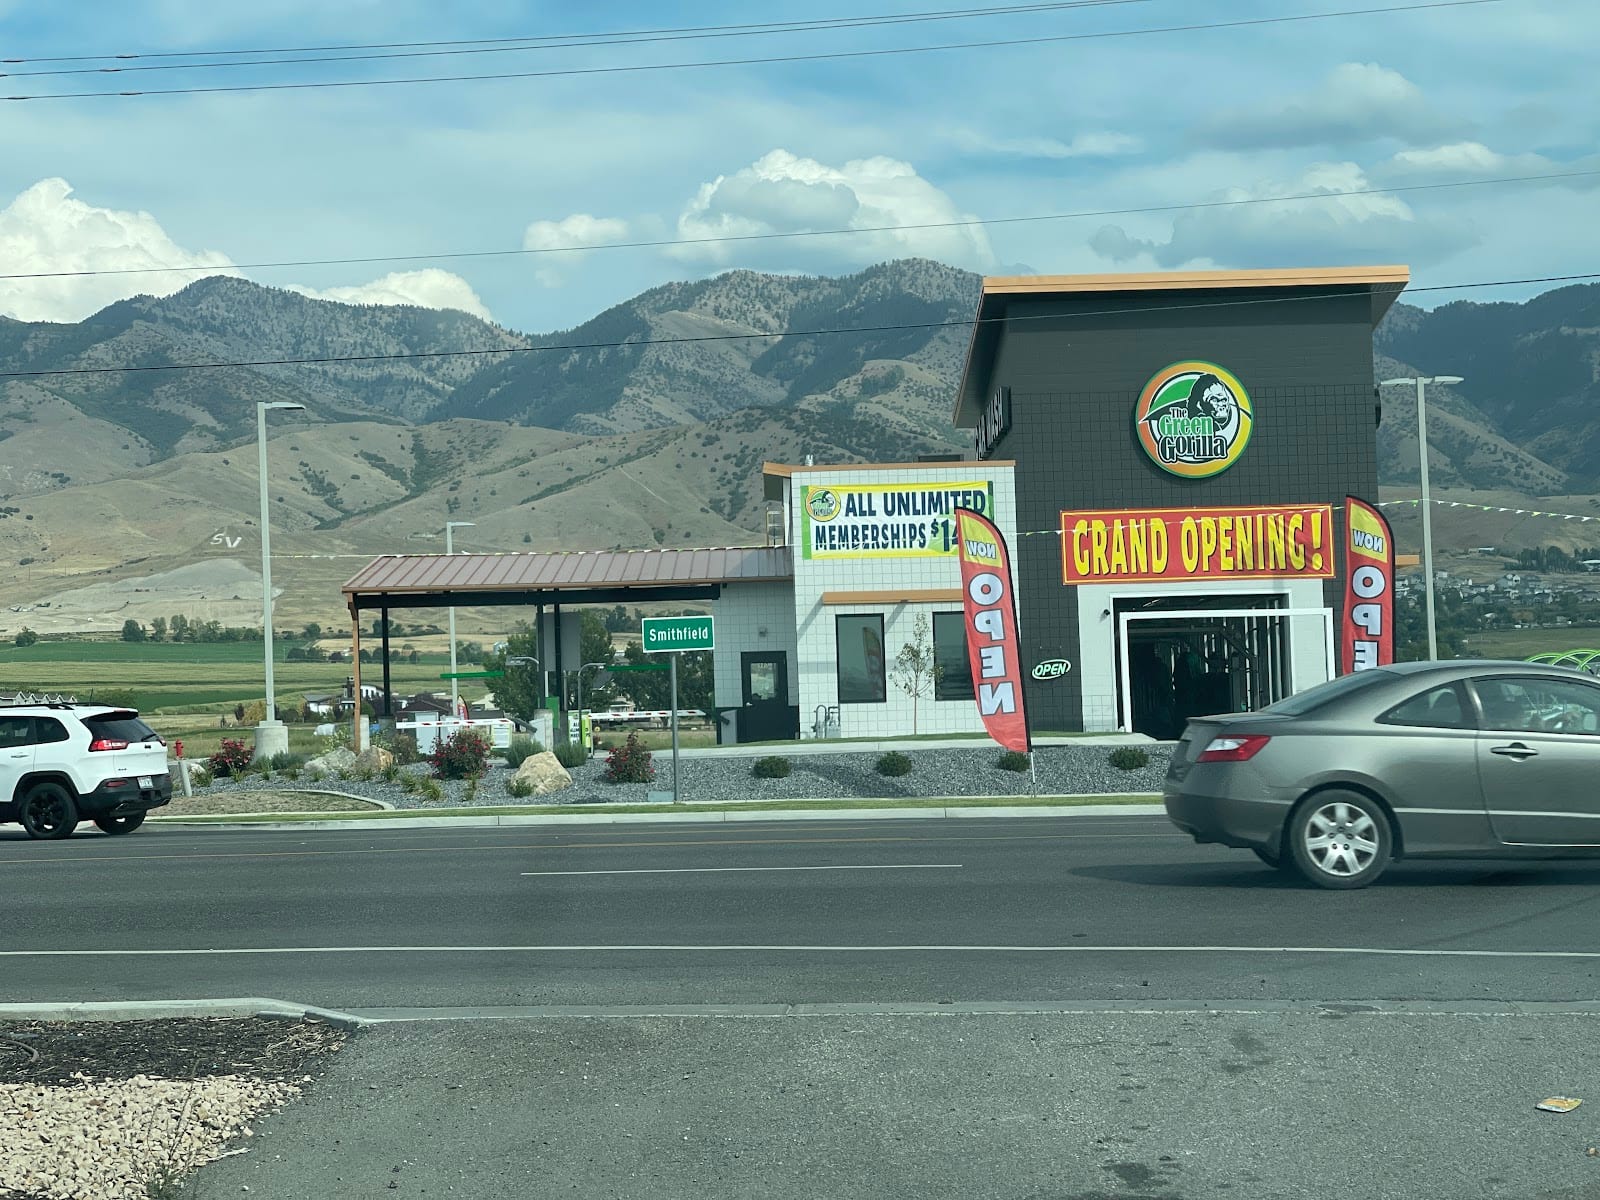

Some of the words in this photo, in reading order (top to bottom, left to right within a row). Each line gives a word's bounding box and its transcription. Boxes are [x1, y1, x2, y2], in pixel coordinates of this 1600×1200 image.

[1170, 407, 1188, 419] The
[1159, 415, 1214, 436] Green
[1159, 436, 1228, 463] Gorilla
[845, 493, 877, 517] ALL
[883, 490, 986, 517] UNLIMITED
[210, 533, 242, 548] SV
[815, 523, 926, 550] MEMBERSHIPS
[1073, 517, 1168, 576] GRAND
[1180, 511, 1324, 574] OPENING!
[649, 627, 709, 641] Smithfield
[1034, 662, 1066, 677] OPEN
